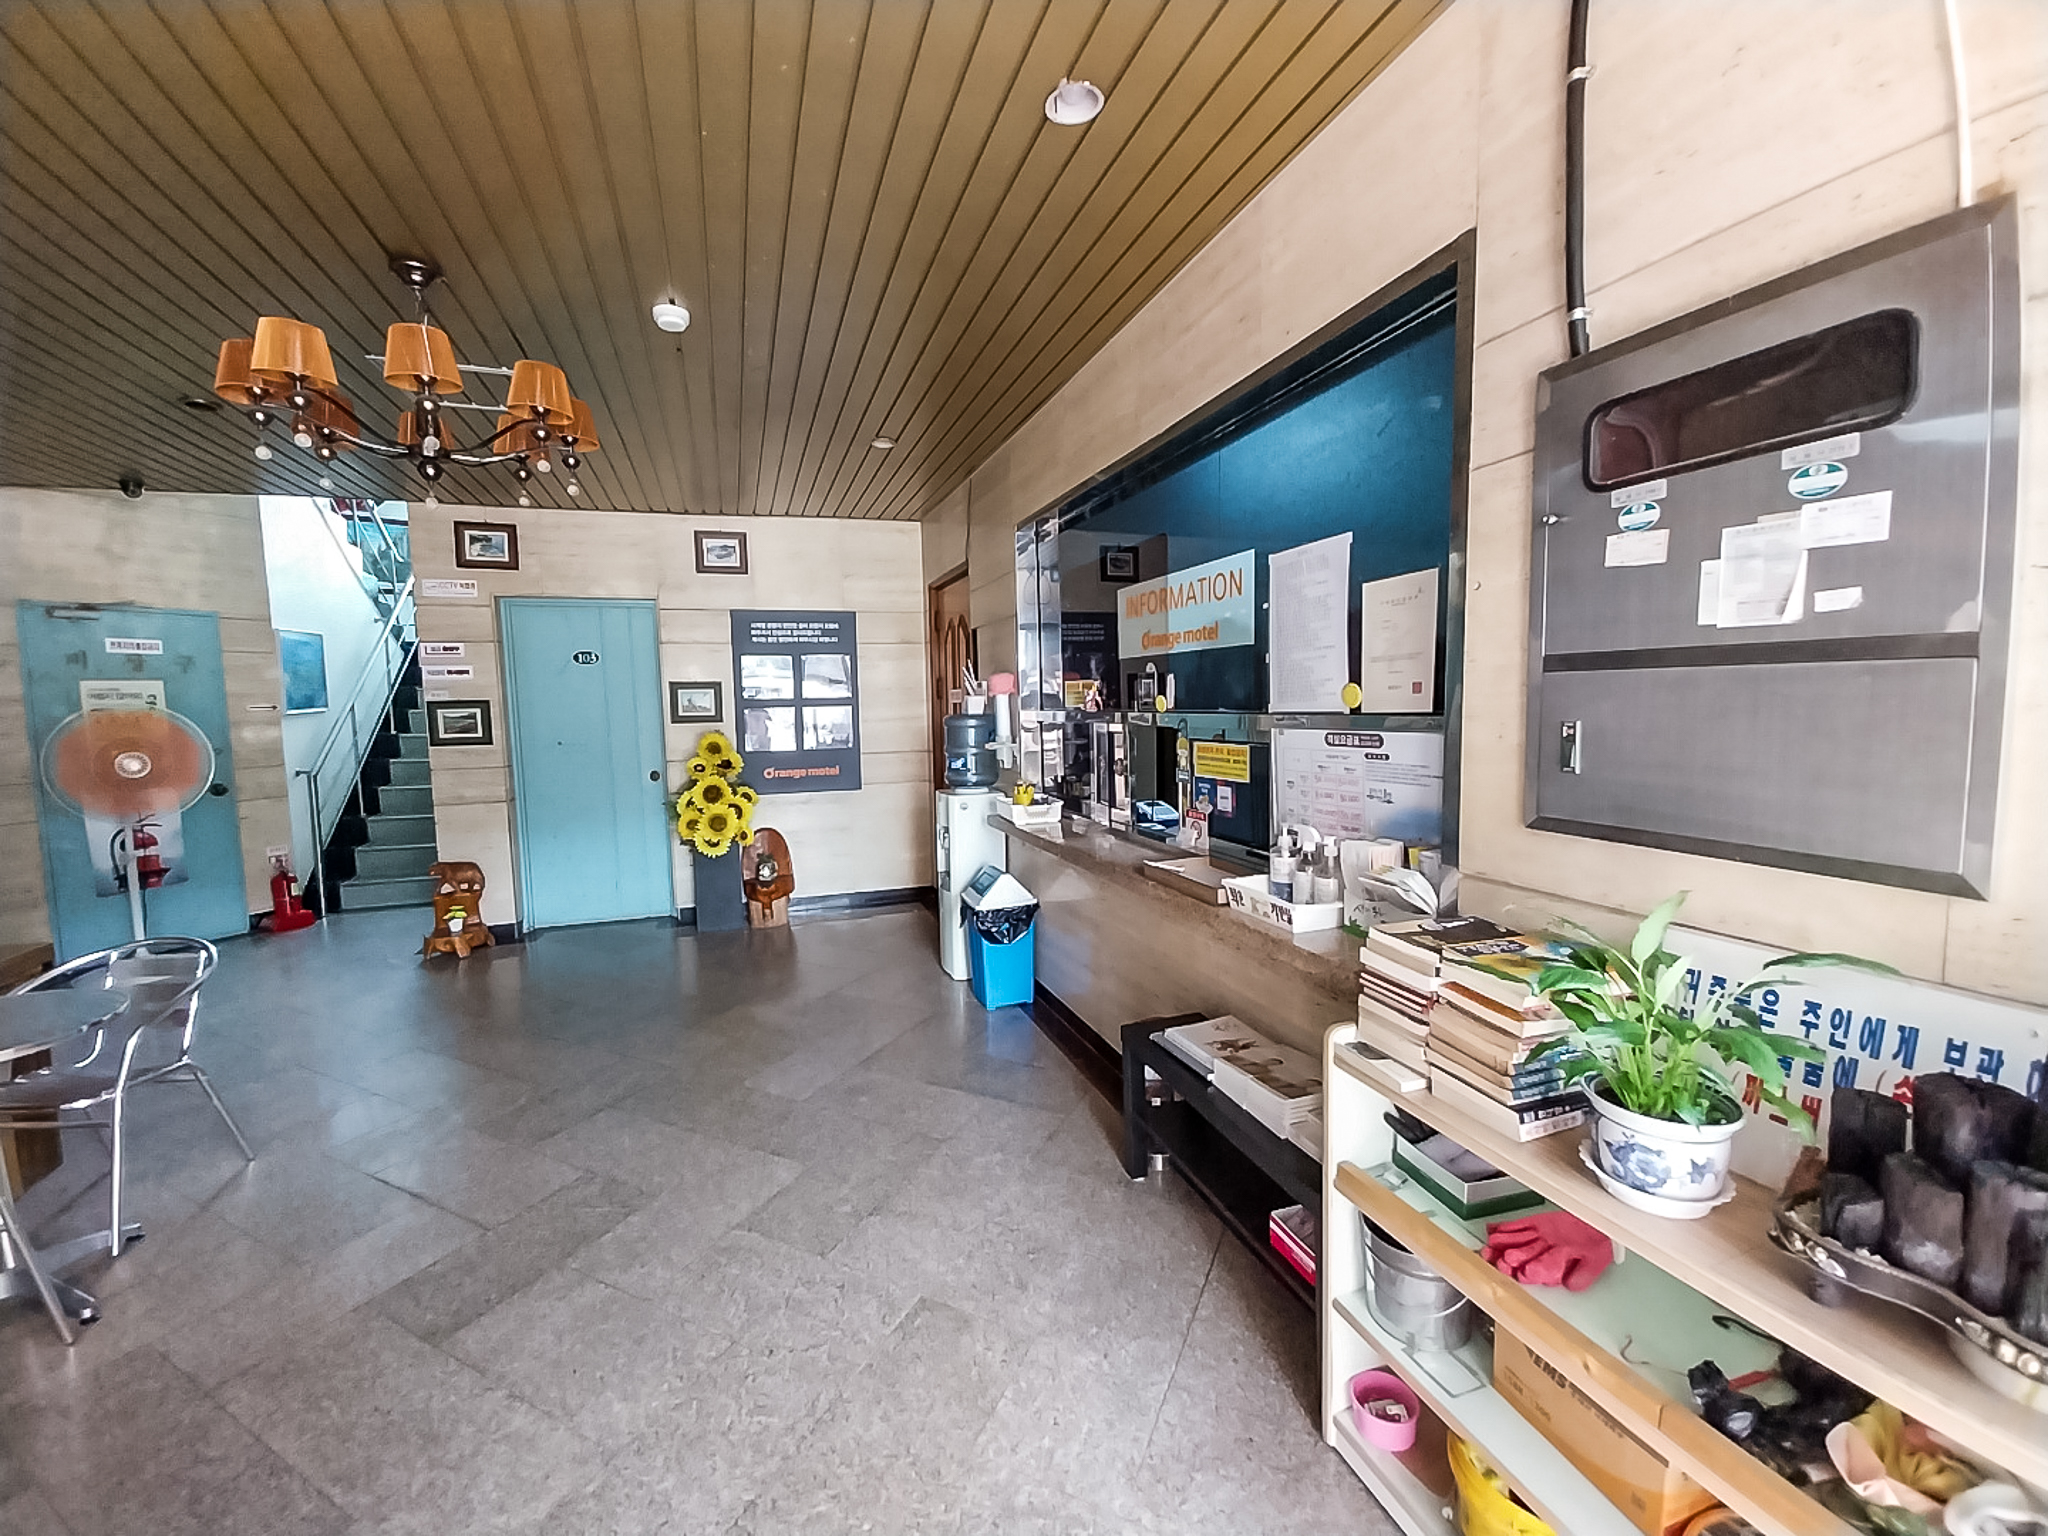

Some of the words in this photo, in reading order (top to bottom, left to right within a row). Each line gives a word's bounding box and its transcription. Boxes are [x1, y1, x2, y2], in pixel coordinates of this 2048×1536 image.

[1125, 567, 1243, 619] INFORMATION
[1142, 628, 1182, 651] Orange
[1183, 620, 1219, 643] motel
[577, 653, 597, 664] 103
[763, 766, 807, 779] Orange
[807, 765, 840, 776] motel
[1799, 999, 1921, 1071] 주인에게
